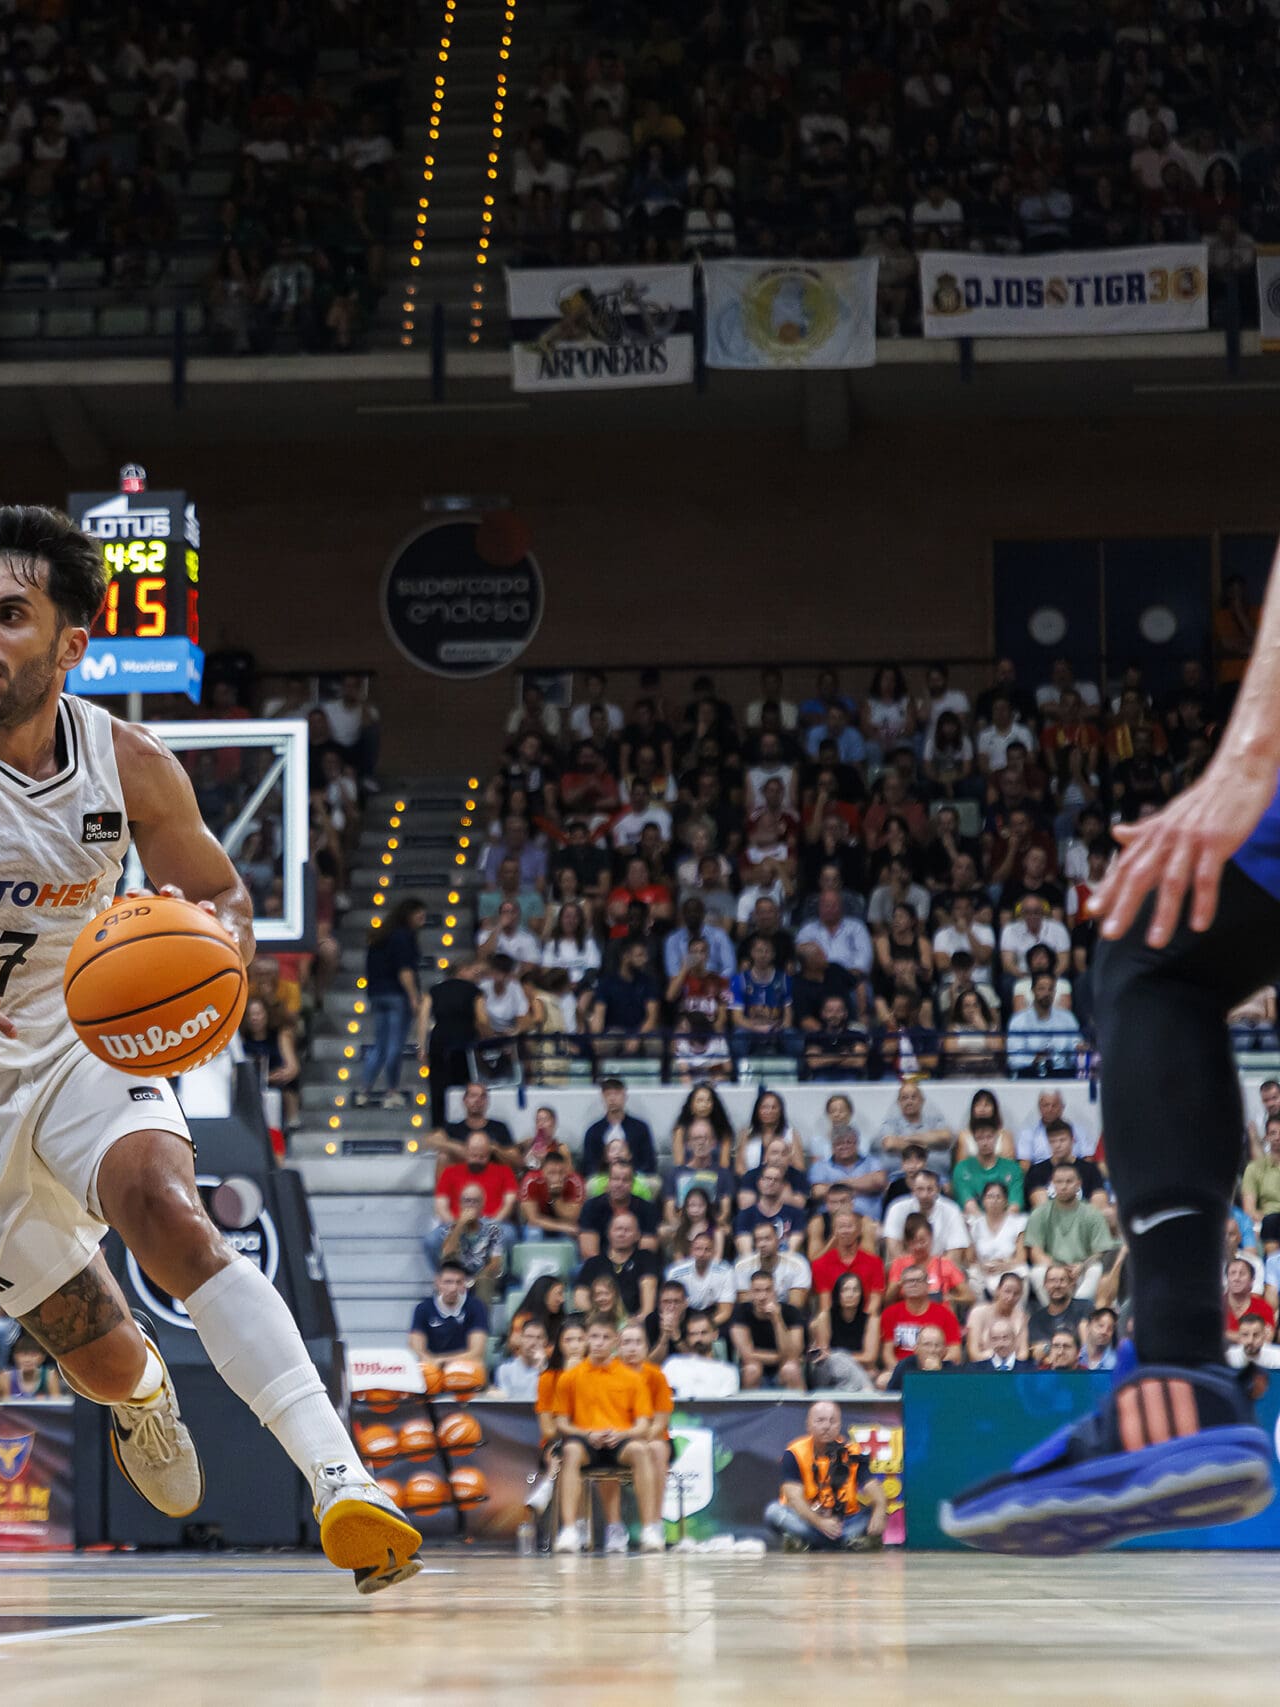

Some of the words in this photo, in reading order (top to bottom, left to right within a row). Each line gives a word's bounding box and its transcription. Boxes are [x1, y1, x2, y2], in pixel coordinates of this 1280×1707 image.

[81, 516, 170, 539] LOTUS
[397, 575, 530, 599] supercopa
[104, 577, 167, 637] 15
[406, 598, 530, 624] endesa
[86, 822, 102, 833] liga
[86, 830, 119, 841] endesa
[98, 1004, 221, 1060] Wilson
[133, 1091, 158, 1101] acb
